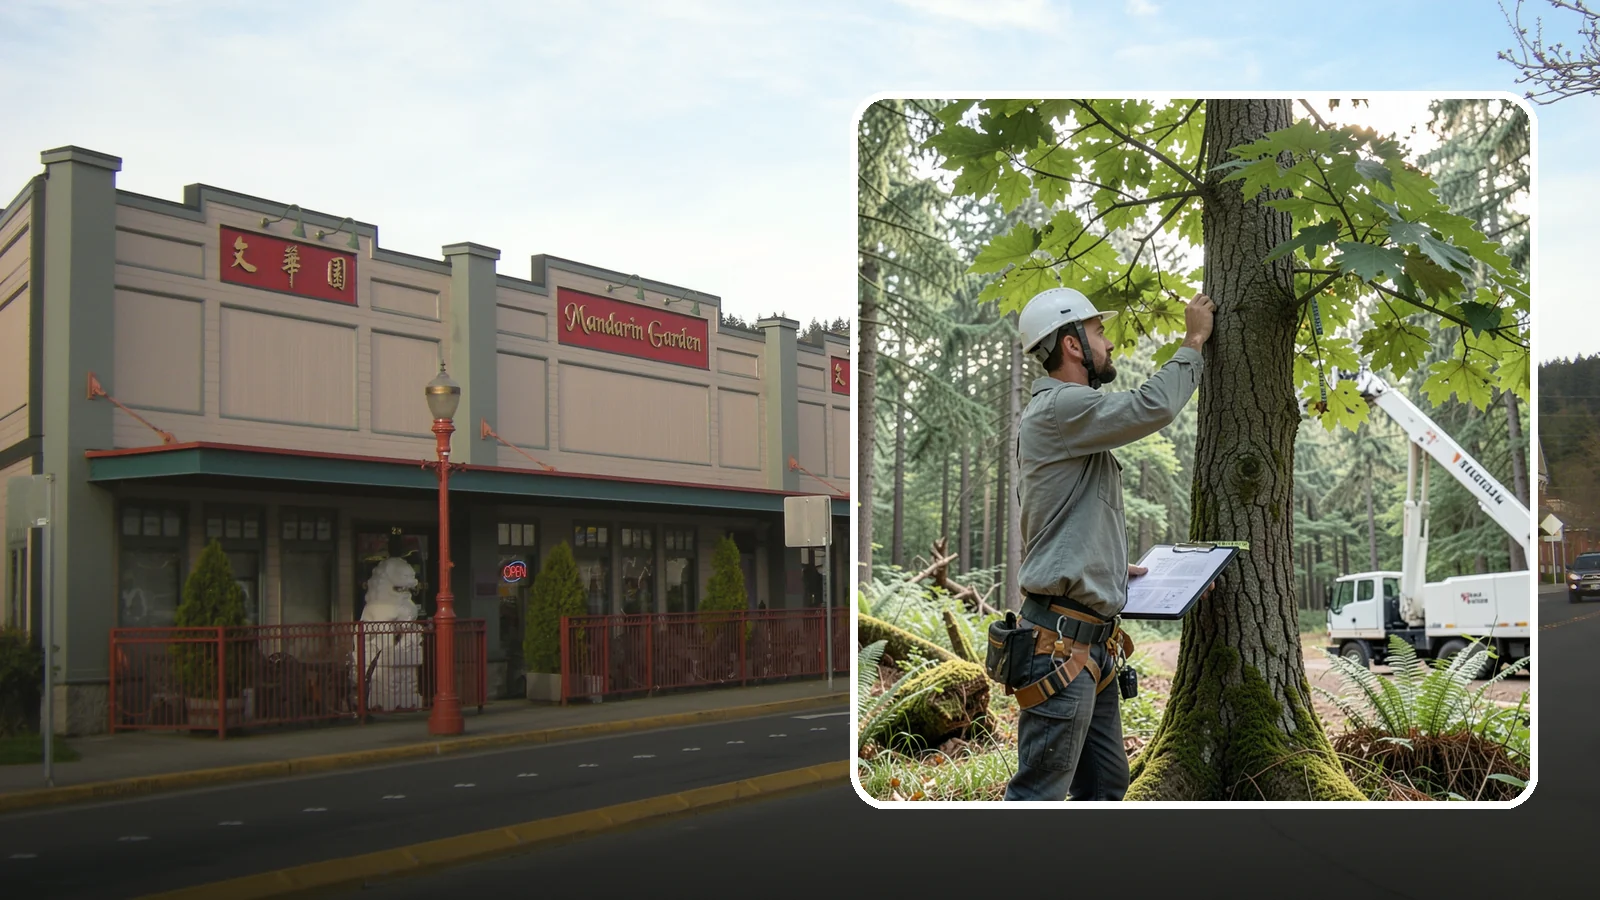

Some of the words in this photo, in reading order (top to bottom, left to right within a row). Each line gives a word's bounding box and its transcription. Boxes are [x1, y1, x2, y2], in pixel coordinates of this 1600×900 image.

[230, 235, 346, 290] 文華園
[564, 302, 644, 341] Mandarin
[648, 320, 701, 352] Garden
[503, 565, 527, 578] OPEN
